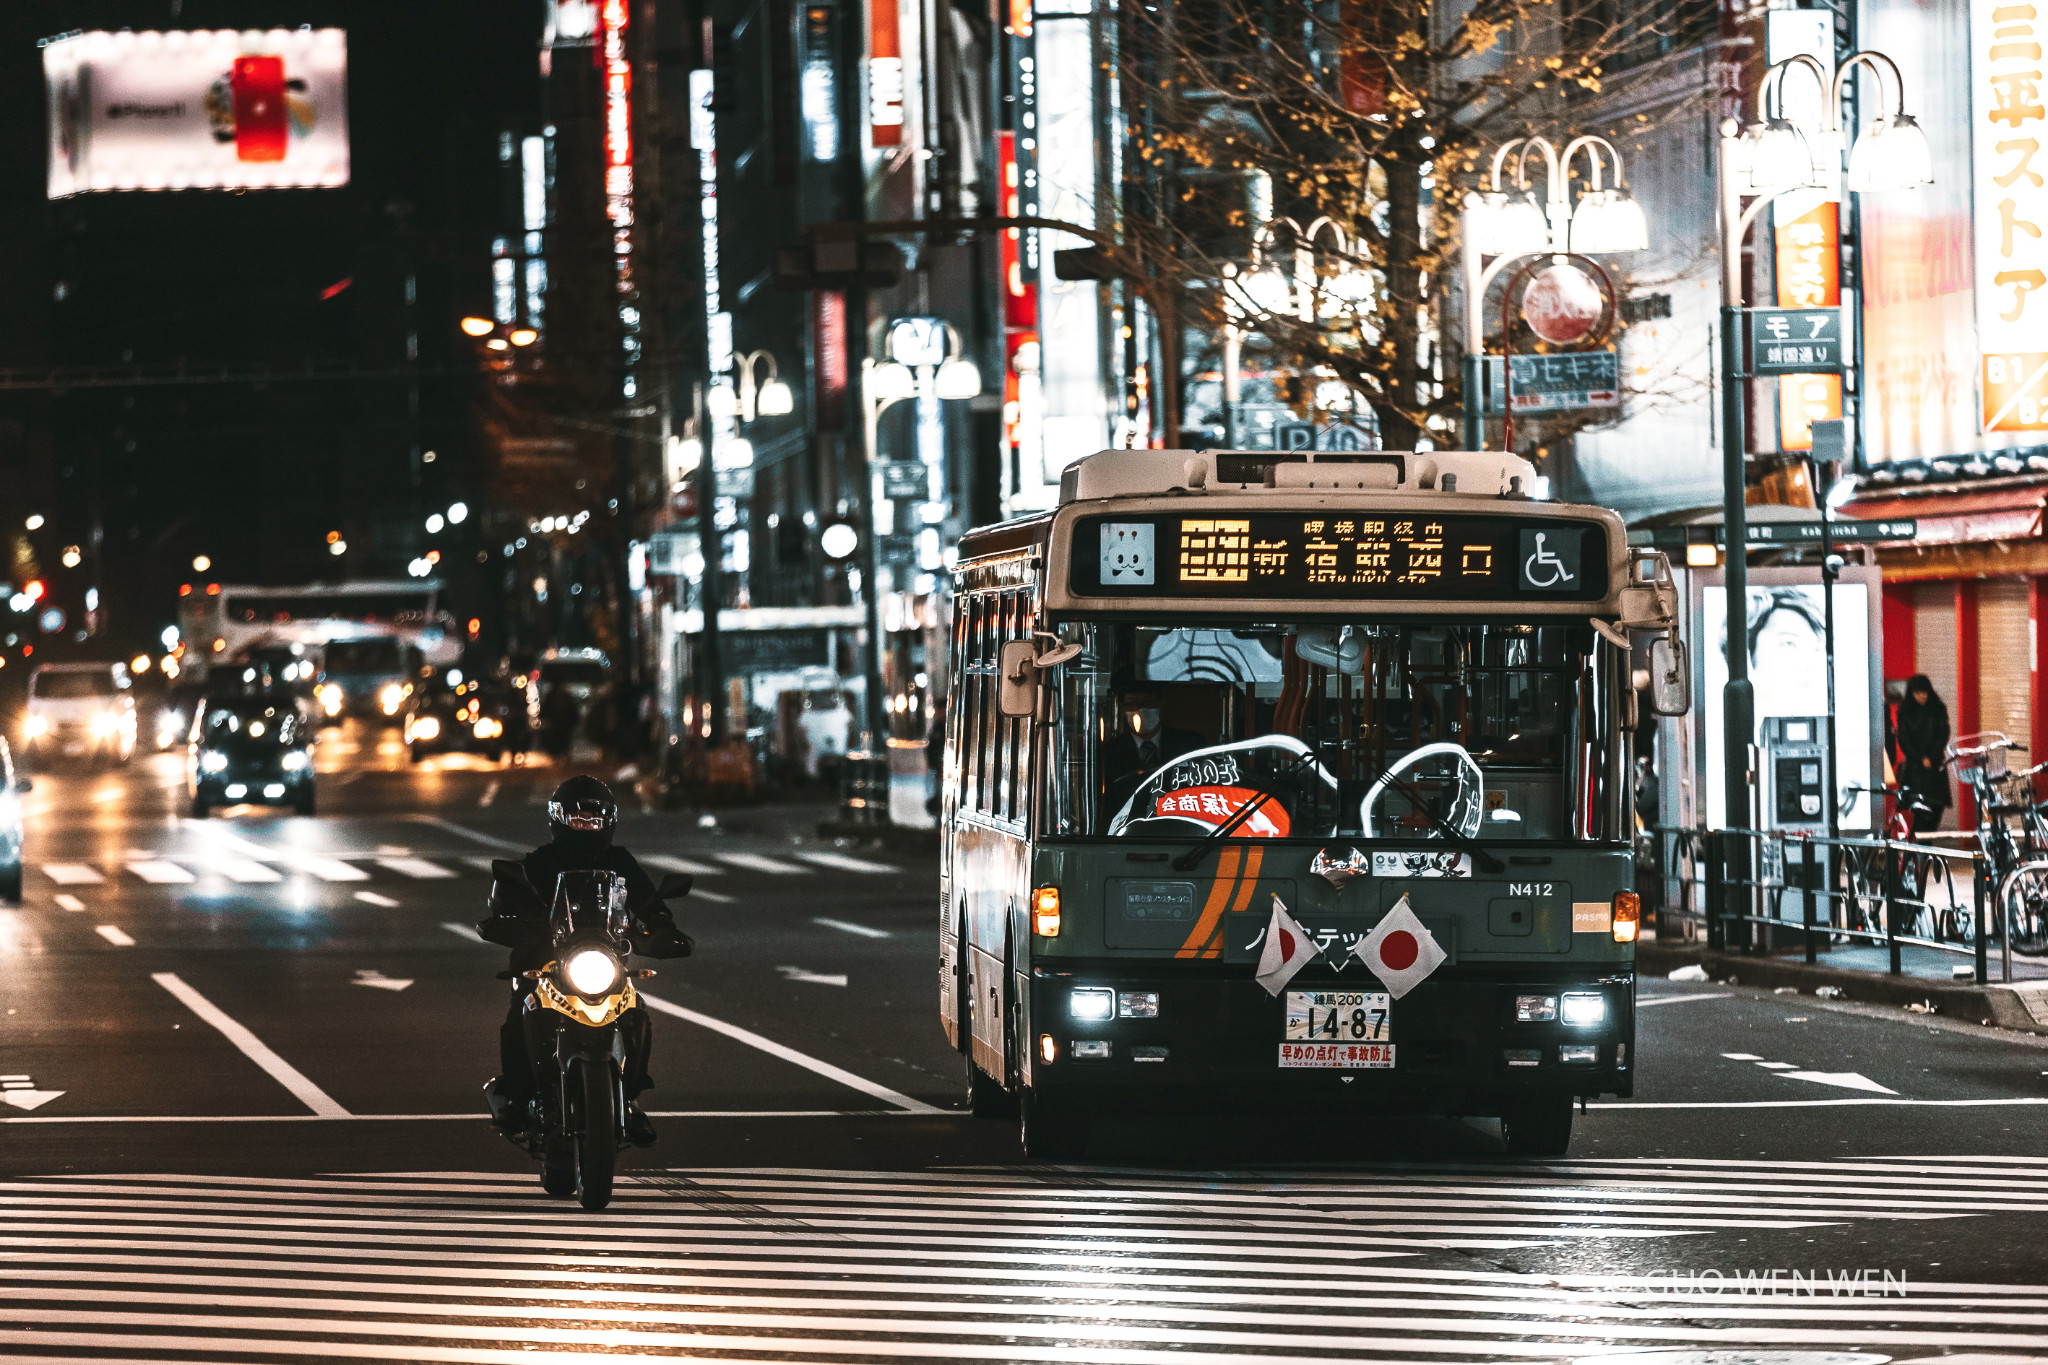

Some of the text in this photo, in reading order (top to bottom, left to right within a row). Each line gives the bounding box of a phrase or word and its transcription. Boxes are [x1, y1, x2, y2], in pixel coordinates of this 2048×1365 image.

[1988, 3, 2047, 323] 三平ストア
[1765, 315, 1830, 339] モア
[1987, 356, 2023, 384] B1
[1509, 883, 1553, 896] N412
[1575, 913, 1608, 922] PASMO
[1308, 1007, 1387, 1039] 14-87
[1281, 1045, 1392, 1062] 早めの点灯で事故防止
